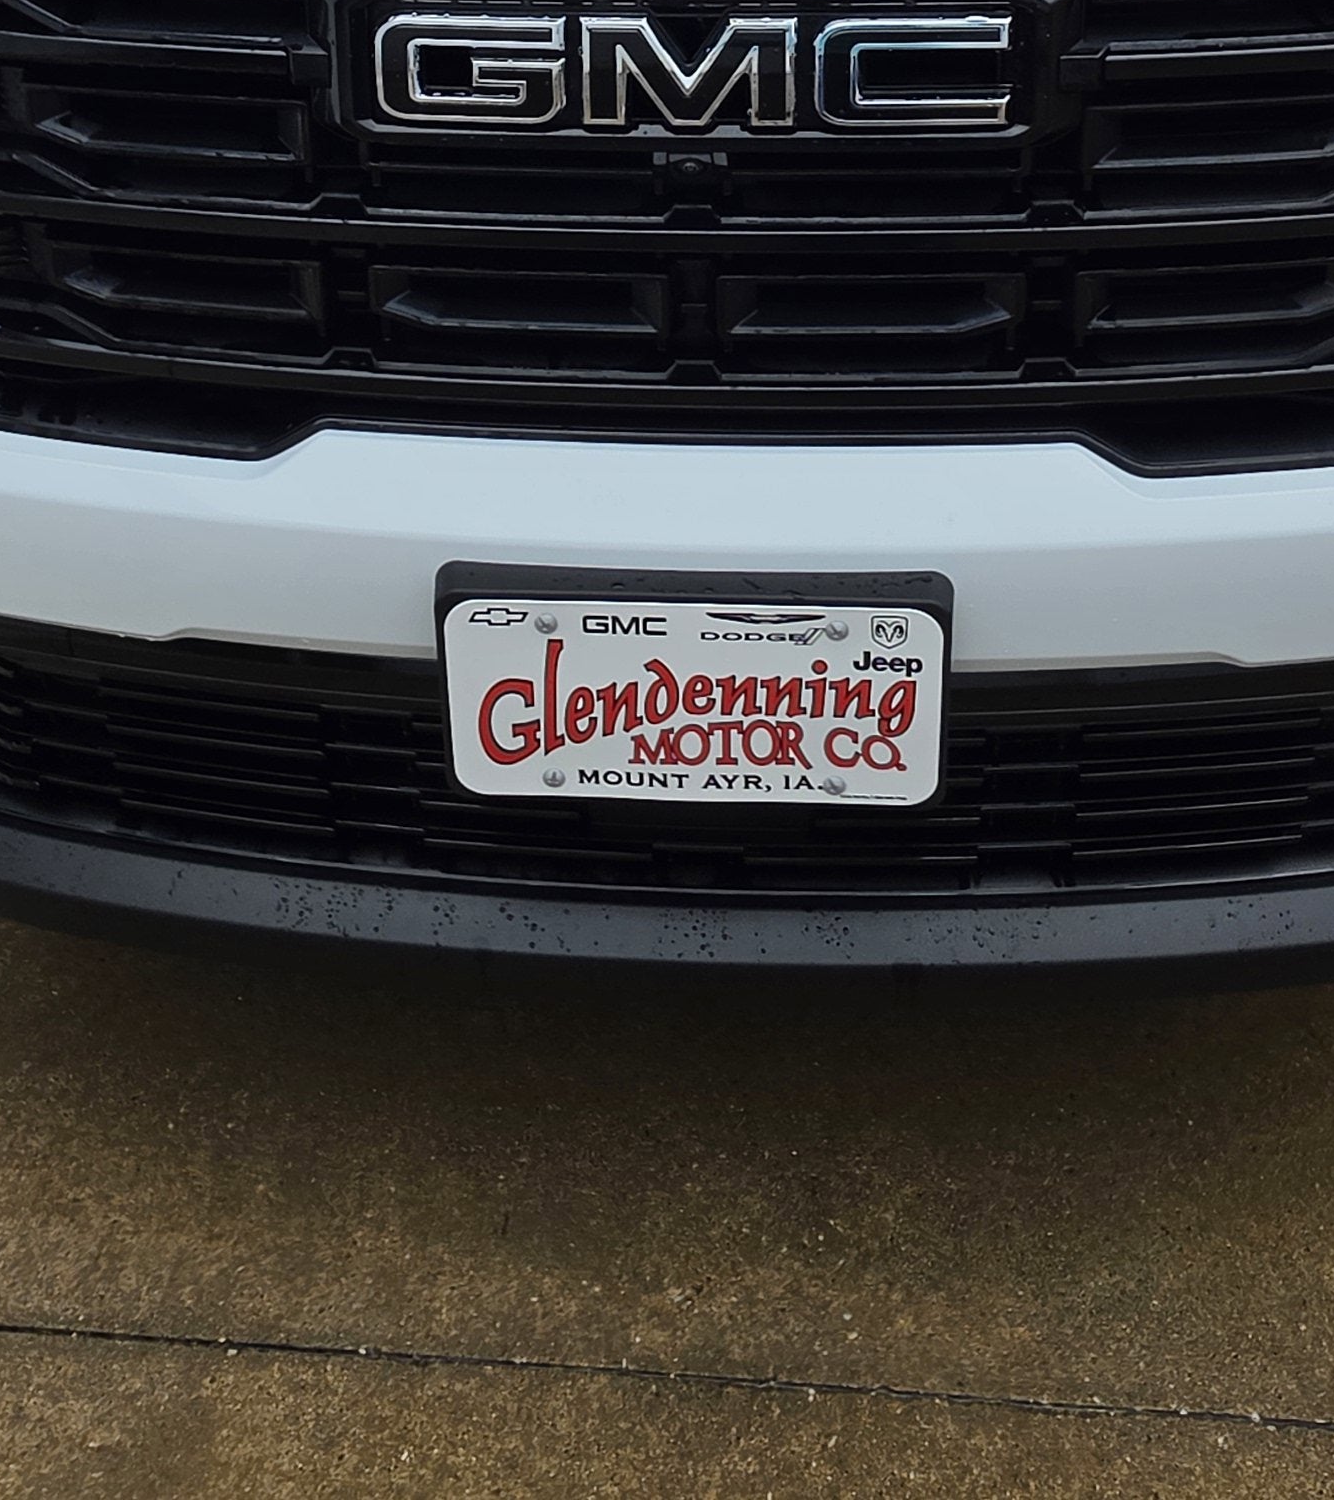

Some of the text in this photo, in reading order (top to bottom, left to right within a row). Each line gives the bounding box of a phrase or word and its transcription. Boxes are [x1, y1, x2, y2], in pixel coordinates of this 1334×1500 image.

[373, 13, 1013, 127] GMC
[581, 615, 807, 642] GMC DODGE
[853, 651, 924, 677] Jeep
[477, 638, 918, 766] Glendenning
[628, 719, 813, 770] MOTOR
[578, 768, 690, 789] MOUNT
[702, 772, 773, 793] AYR,
